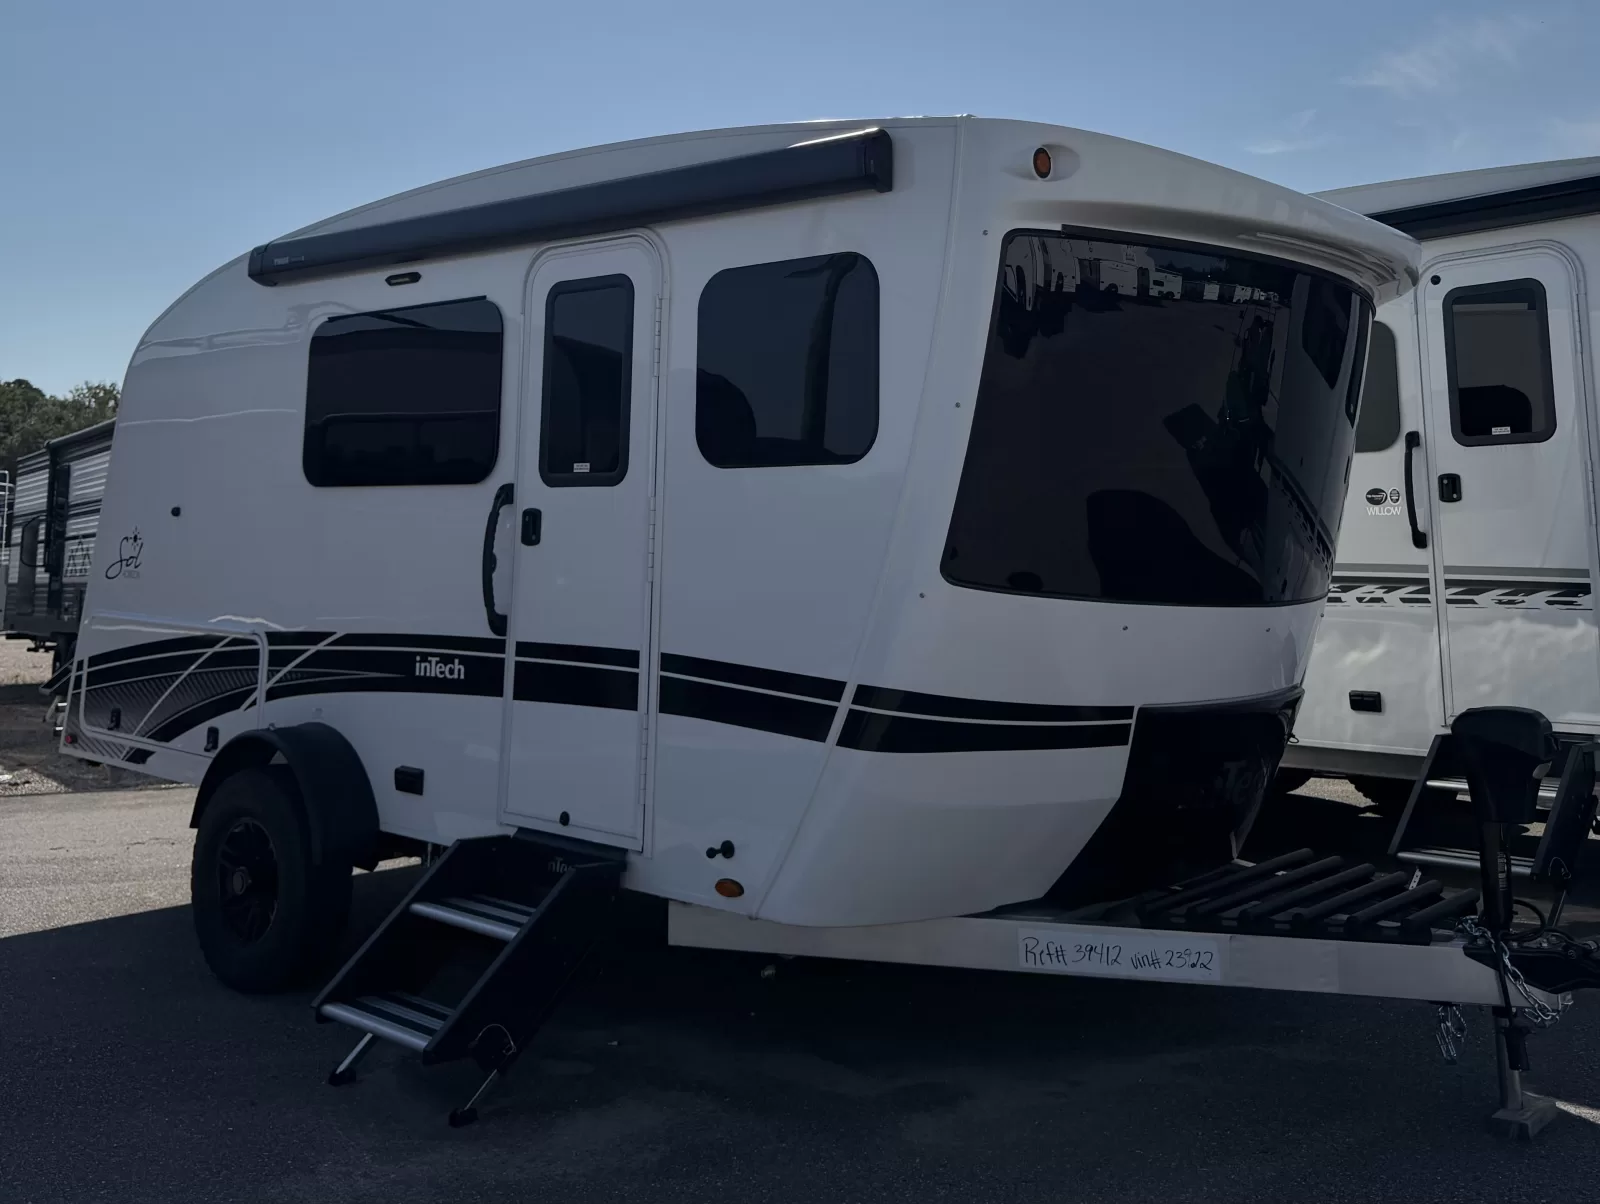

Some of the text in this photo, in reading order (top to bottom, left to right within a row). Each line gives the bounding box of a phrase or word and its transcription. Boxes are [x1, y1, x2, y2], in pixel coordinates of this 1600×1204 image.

[1365, 506, 1402, 516] WILLOW
[105, 536, 144, 580] Sol
[415, 655, 465, 680] inTech
[1022, 936, 1067, 967] Ref#
[1072, 943, 1122, 967] 39412
